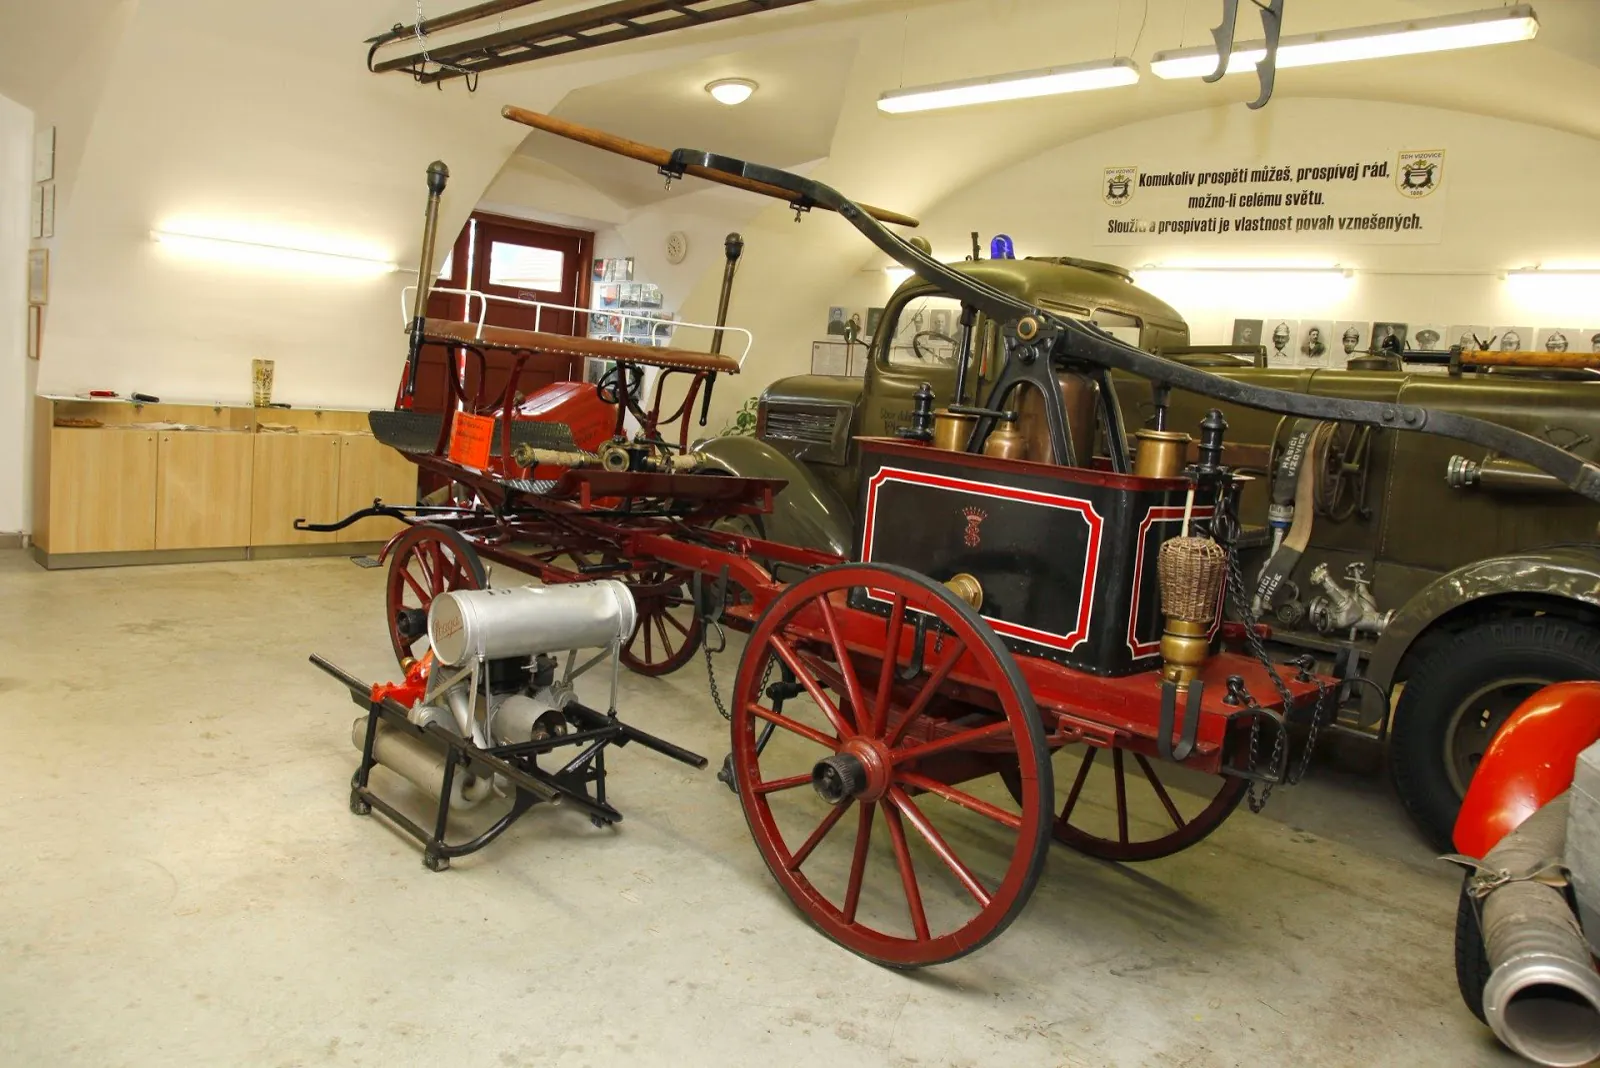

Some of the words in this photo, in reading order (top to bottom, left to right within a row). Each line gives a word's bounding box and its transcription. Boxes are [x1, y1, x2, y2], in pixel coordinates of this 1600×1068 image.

[1139, 171, 1195, 187] Komukoliv
[1197, 168, 1248, 187] prospěti
[1250, 165, 1293, 182] můžeš,
[1296, 163, 1360, 183] prospívej
[1362, 161, 1390, 179] rád,
[1188, 193, 1236, 209] možno-li
[1239, 192, 1282, 208] celému
[1285, 190, 1325, 206] světu.
[1149, 220, 1156, 233] a
[1217, 217, 1230, 234] je
[1235, 215, 1293, 231] vlastnost
[1296, 215, 1334, 233] povah
[1339, 213, 1422, 232] vznešených.
[1288, 432, 1308, 477] VIZOVICE
